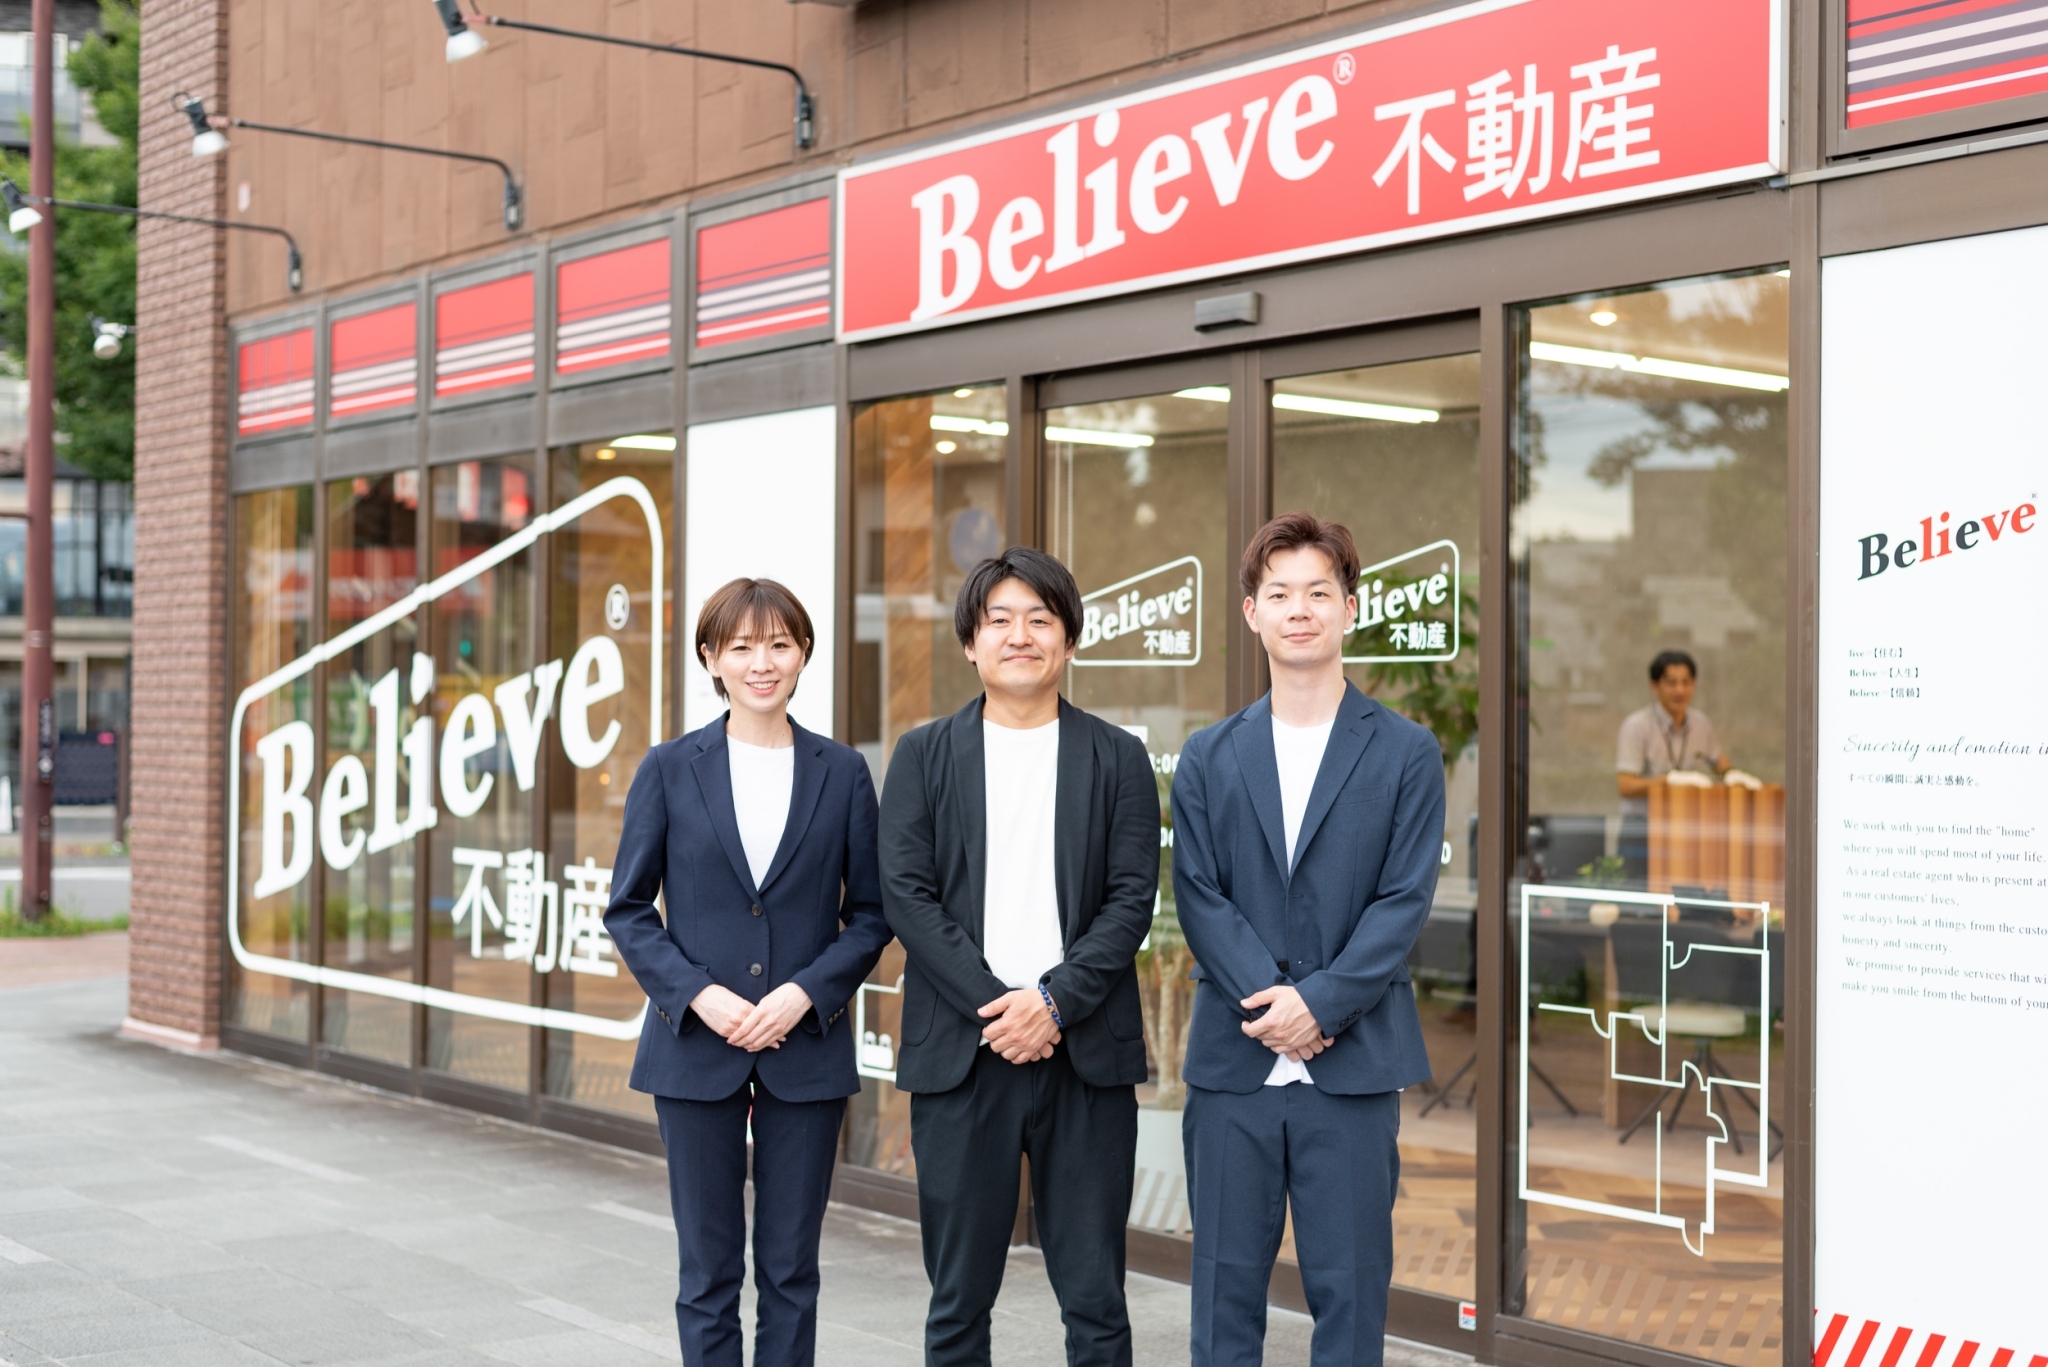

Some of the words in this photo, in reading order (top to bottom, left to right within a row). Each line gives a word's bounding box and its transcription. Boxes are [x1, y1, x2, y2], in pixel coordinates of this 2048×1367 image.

[1371, 44, 1661, 216] 不動産
[1143, 629, 1191, 655] 不動産
[1389, 621, 1446, 650] 不動産
[1843, 735, 1920, 762] Sincerity
[1926, 736, 1965, 757] and
[1964, 741, 2033, 755] emotion
[1843, 819, 1859, 829] We
[1862, 821, 1887, 831] work
[1890, 822, 1912, 832] with
[1915, 825, 1934, 836] you
[1937, 825, 1948, 834] to
[1951, 824, 1972, 835] find
[1976, 825, 1992, 836] the
[1843, 842, 1872, 854] where
[1875, 847, 1893, 857] you
[1897, 845, 1917, 856] will
[1919, 848, 1949, 859] spend
[1953, 849, 1977, 859] most
[1981, 850, 1993, 860] of
[1996, 852, 2021, 864] your
[1846, 866, 1859, 876] As
[1870, 868, 1889, 877] real
[1892, 869, 1922, 880] estate
[1925, 872, 1953, 883] agent
[1956, 872, 1979, 883] who
[1982, 873, 1991, 883] is
[1994, 876, 2033, 887] present
[2036, 878, 2047, 887] at
[1842, 888, 1852, 898] in
[1855, 891, 1871, 899] our
[450, 847, 618, 978] 不動産
[1842, 912, 1856, 922] we
[1859, 912, 1893, 926] always
[1896, 915, 1918, 926] look
[1921, 917, 1931, 927] at
[1934, 917, 1966, 932] things
[1970, 920, 1995, 932] from
[1998, 922, 2015, 934] the
[1842, 934, 1880, 949] honesty
[1883, 938, 1901, 948] and
[1845, 957, 1862, 967] We
[1864, 961, 1904, 972] promise
[1907, 964, 1918, 973] to
[1920, 965, 1960, 978] provide
[1963, 969, 2007, 982] services
[2009, 971, 2030, 983] that
[1842, 981, 1868, 992] make
[1871, 984, 1889, 995] you
[1892, 986, 1920, 997] smile
[1922, 987, 1947, 1000] from
[1950, 990, 1967, 1001] the
[1970, 992, 2008, 1005] bottom
[2010, 995, 2024, 1007] of
